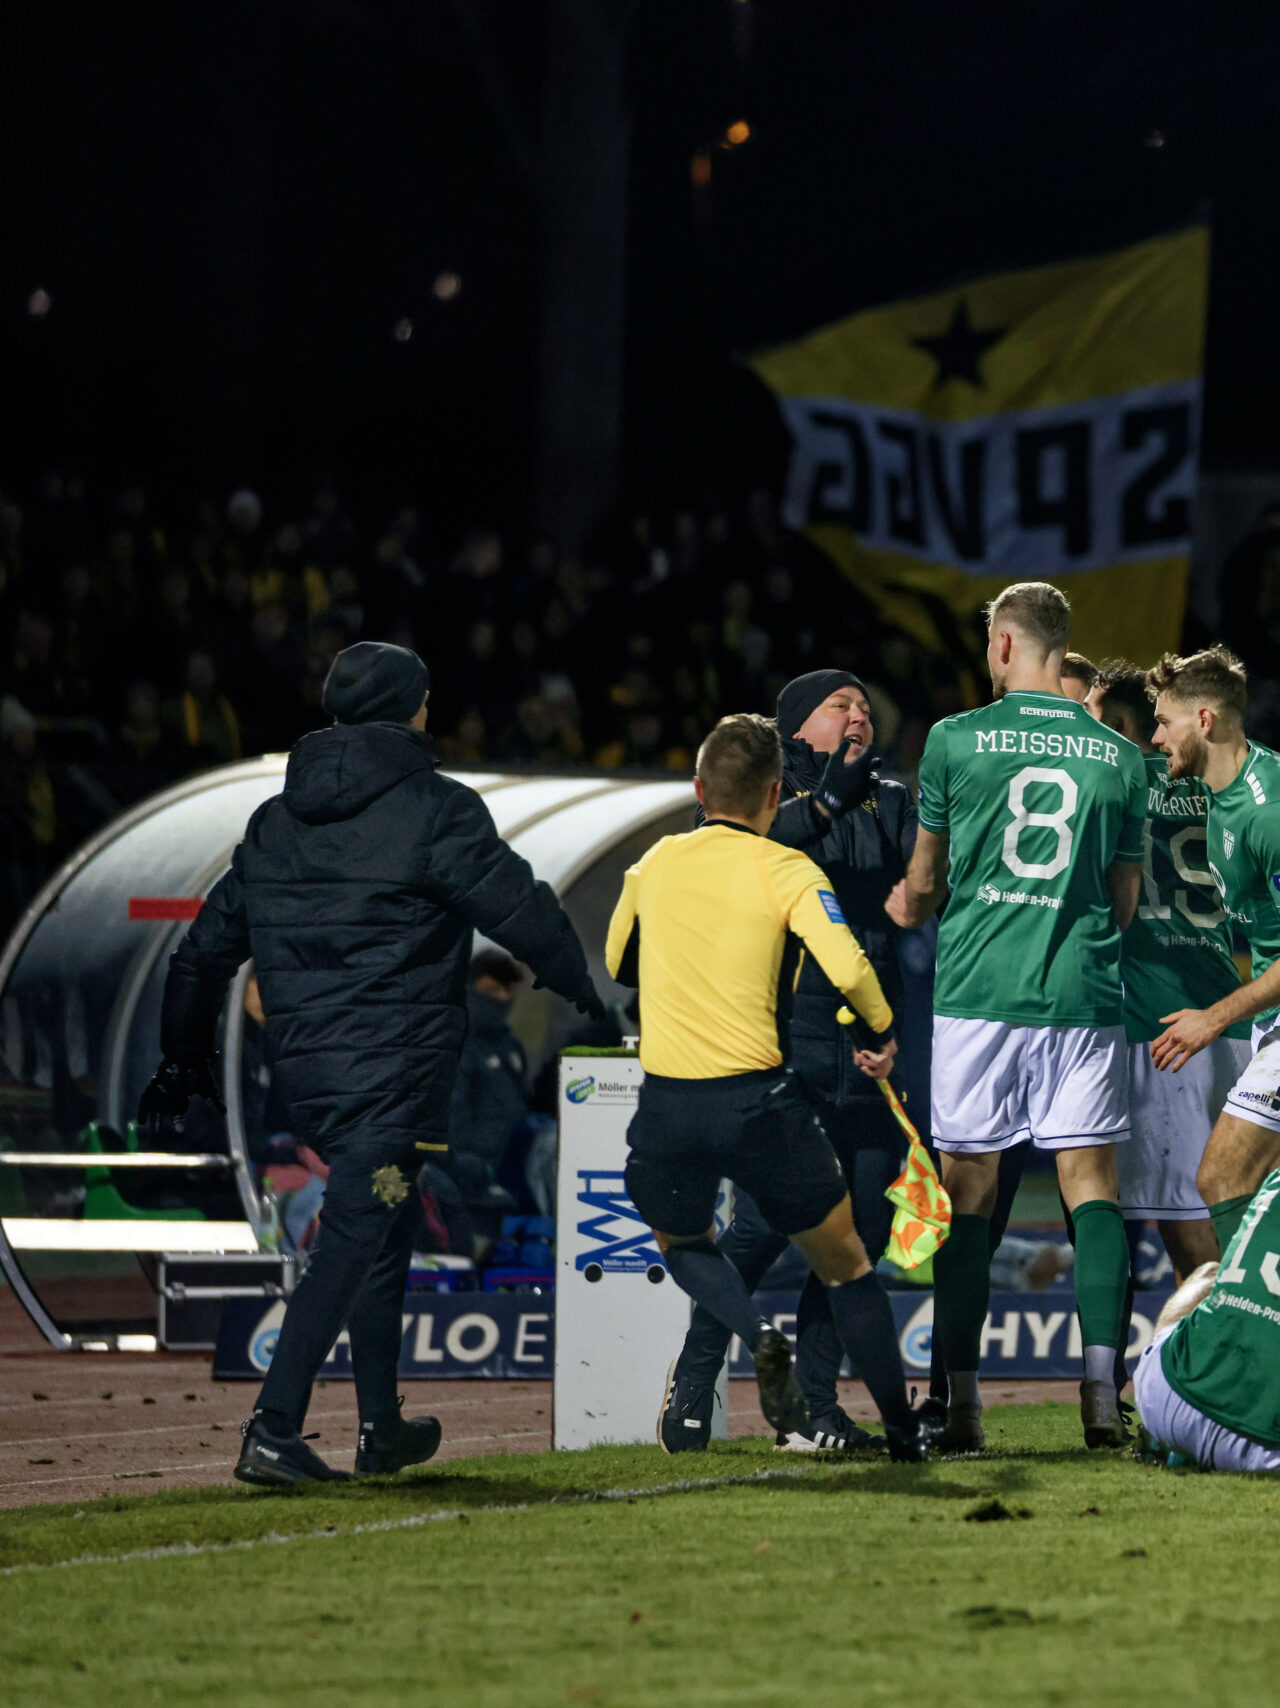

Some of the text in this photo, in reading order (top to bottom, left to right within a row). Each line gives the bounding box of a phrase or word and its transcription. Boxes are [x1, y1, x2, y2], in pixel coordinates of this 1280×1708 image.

[1019, 706, 1076, 720] SCHNUDEL
[975, 729, 1120, 767] MEISSNER
[1001, 766, 1079, 880] 8
[599, 1082, 627, 1092] Möller
[1238, 1090, 1270, 1104] capelli
